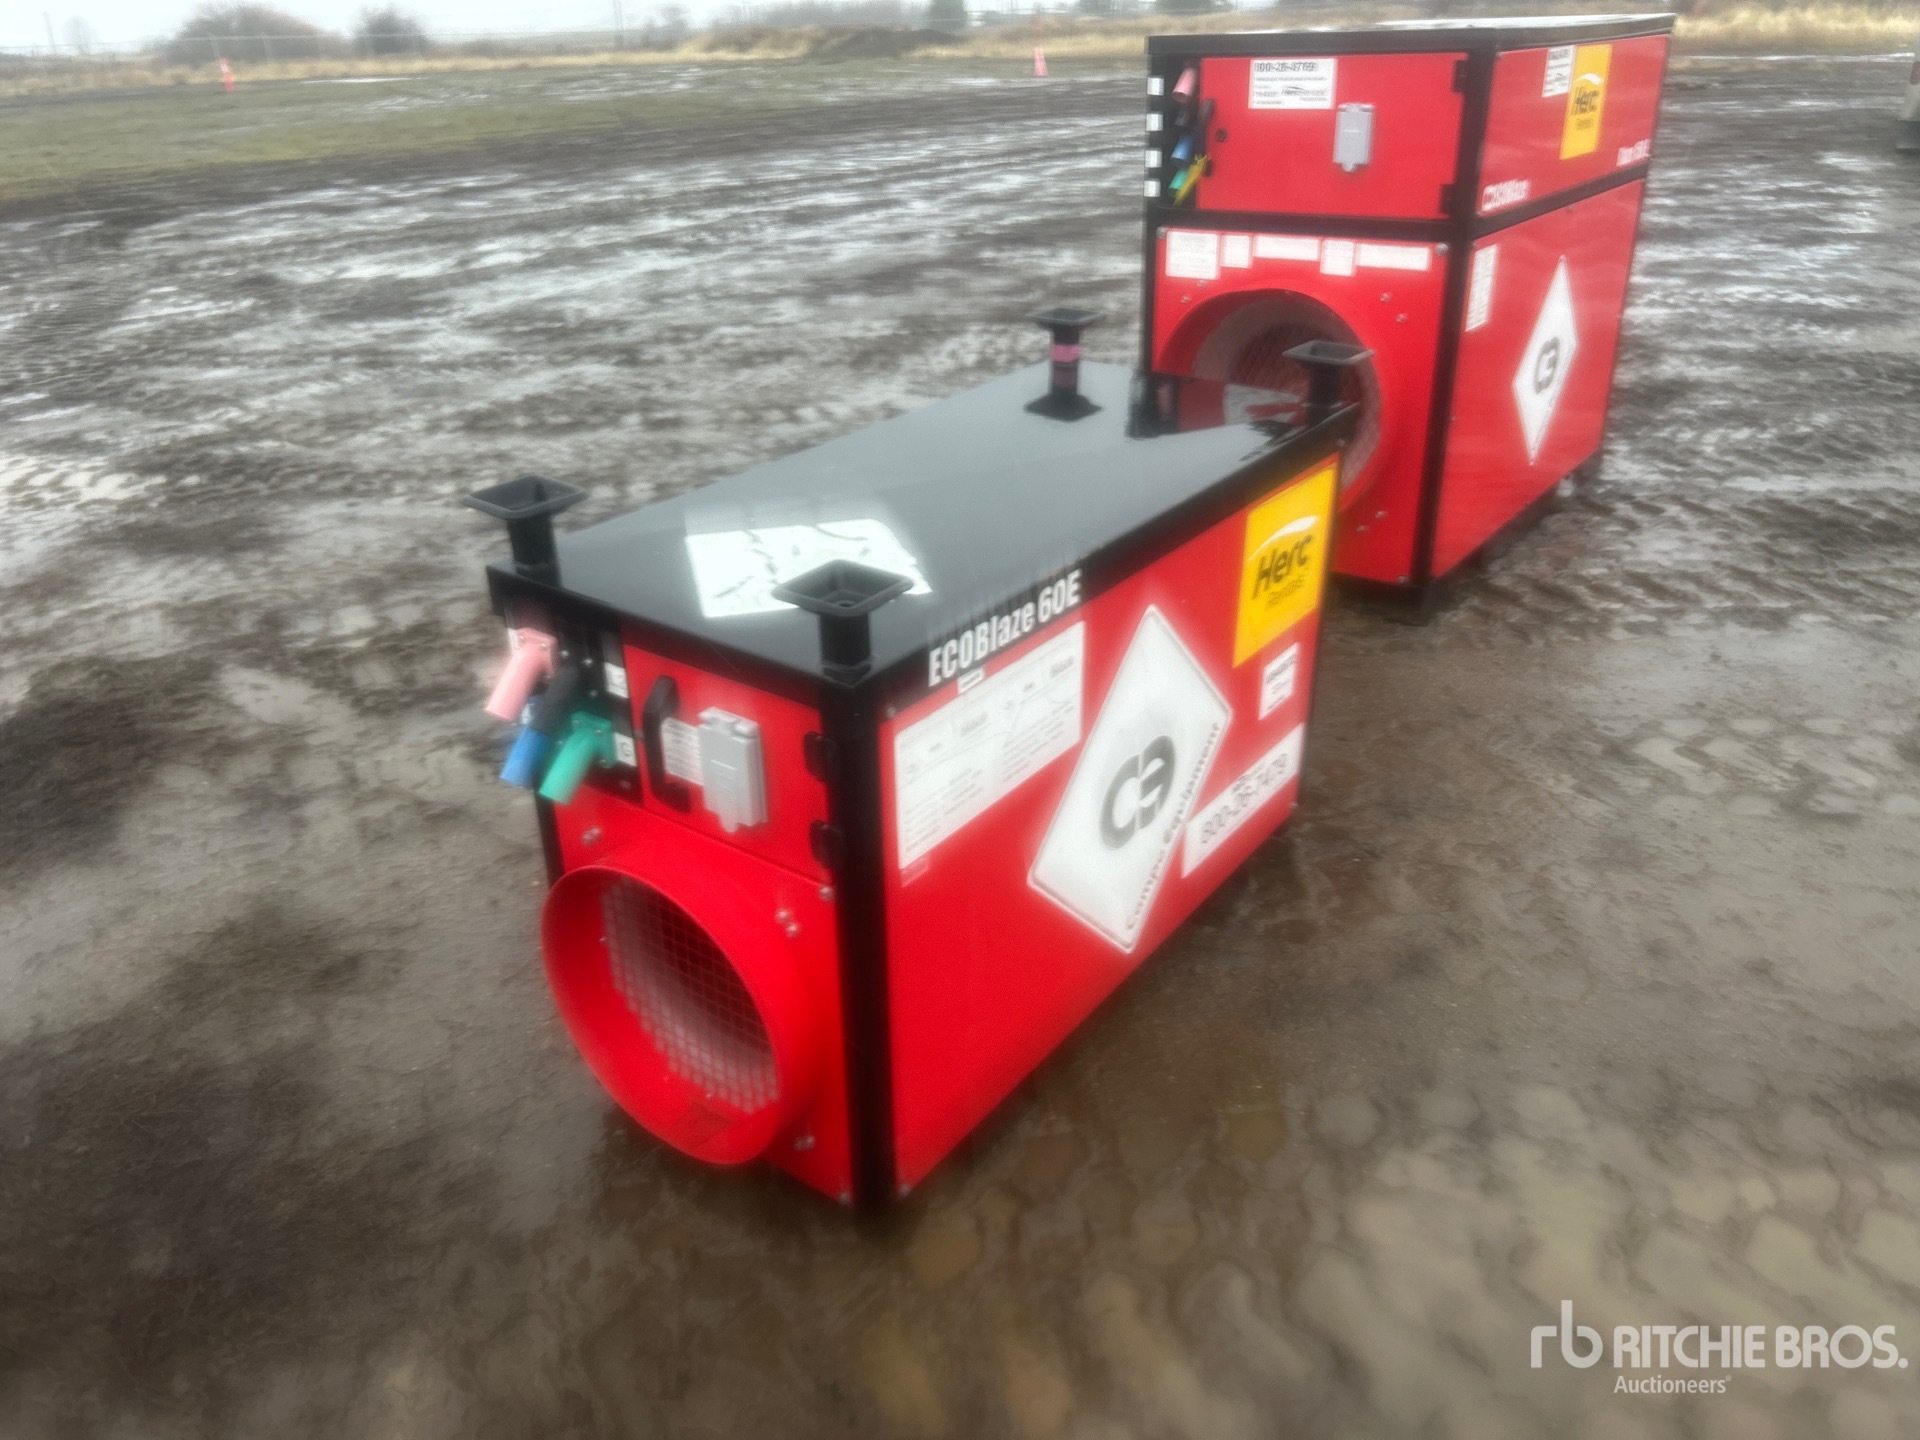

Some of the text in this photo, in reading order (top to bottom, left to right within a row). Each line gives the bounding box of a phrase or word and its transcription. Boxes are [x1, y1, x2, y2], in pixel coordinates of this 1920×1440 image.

[1252, 533, 1314, 600] Herc
[928, 568, 1083, 687] ECOBlaze 60E
